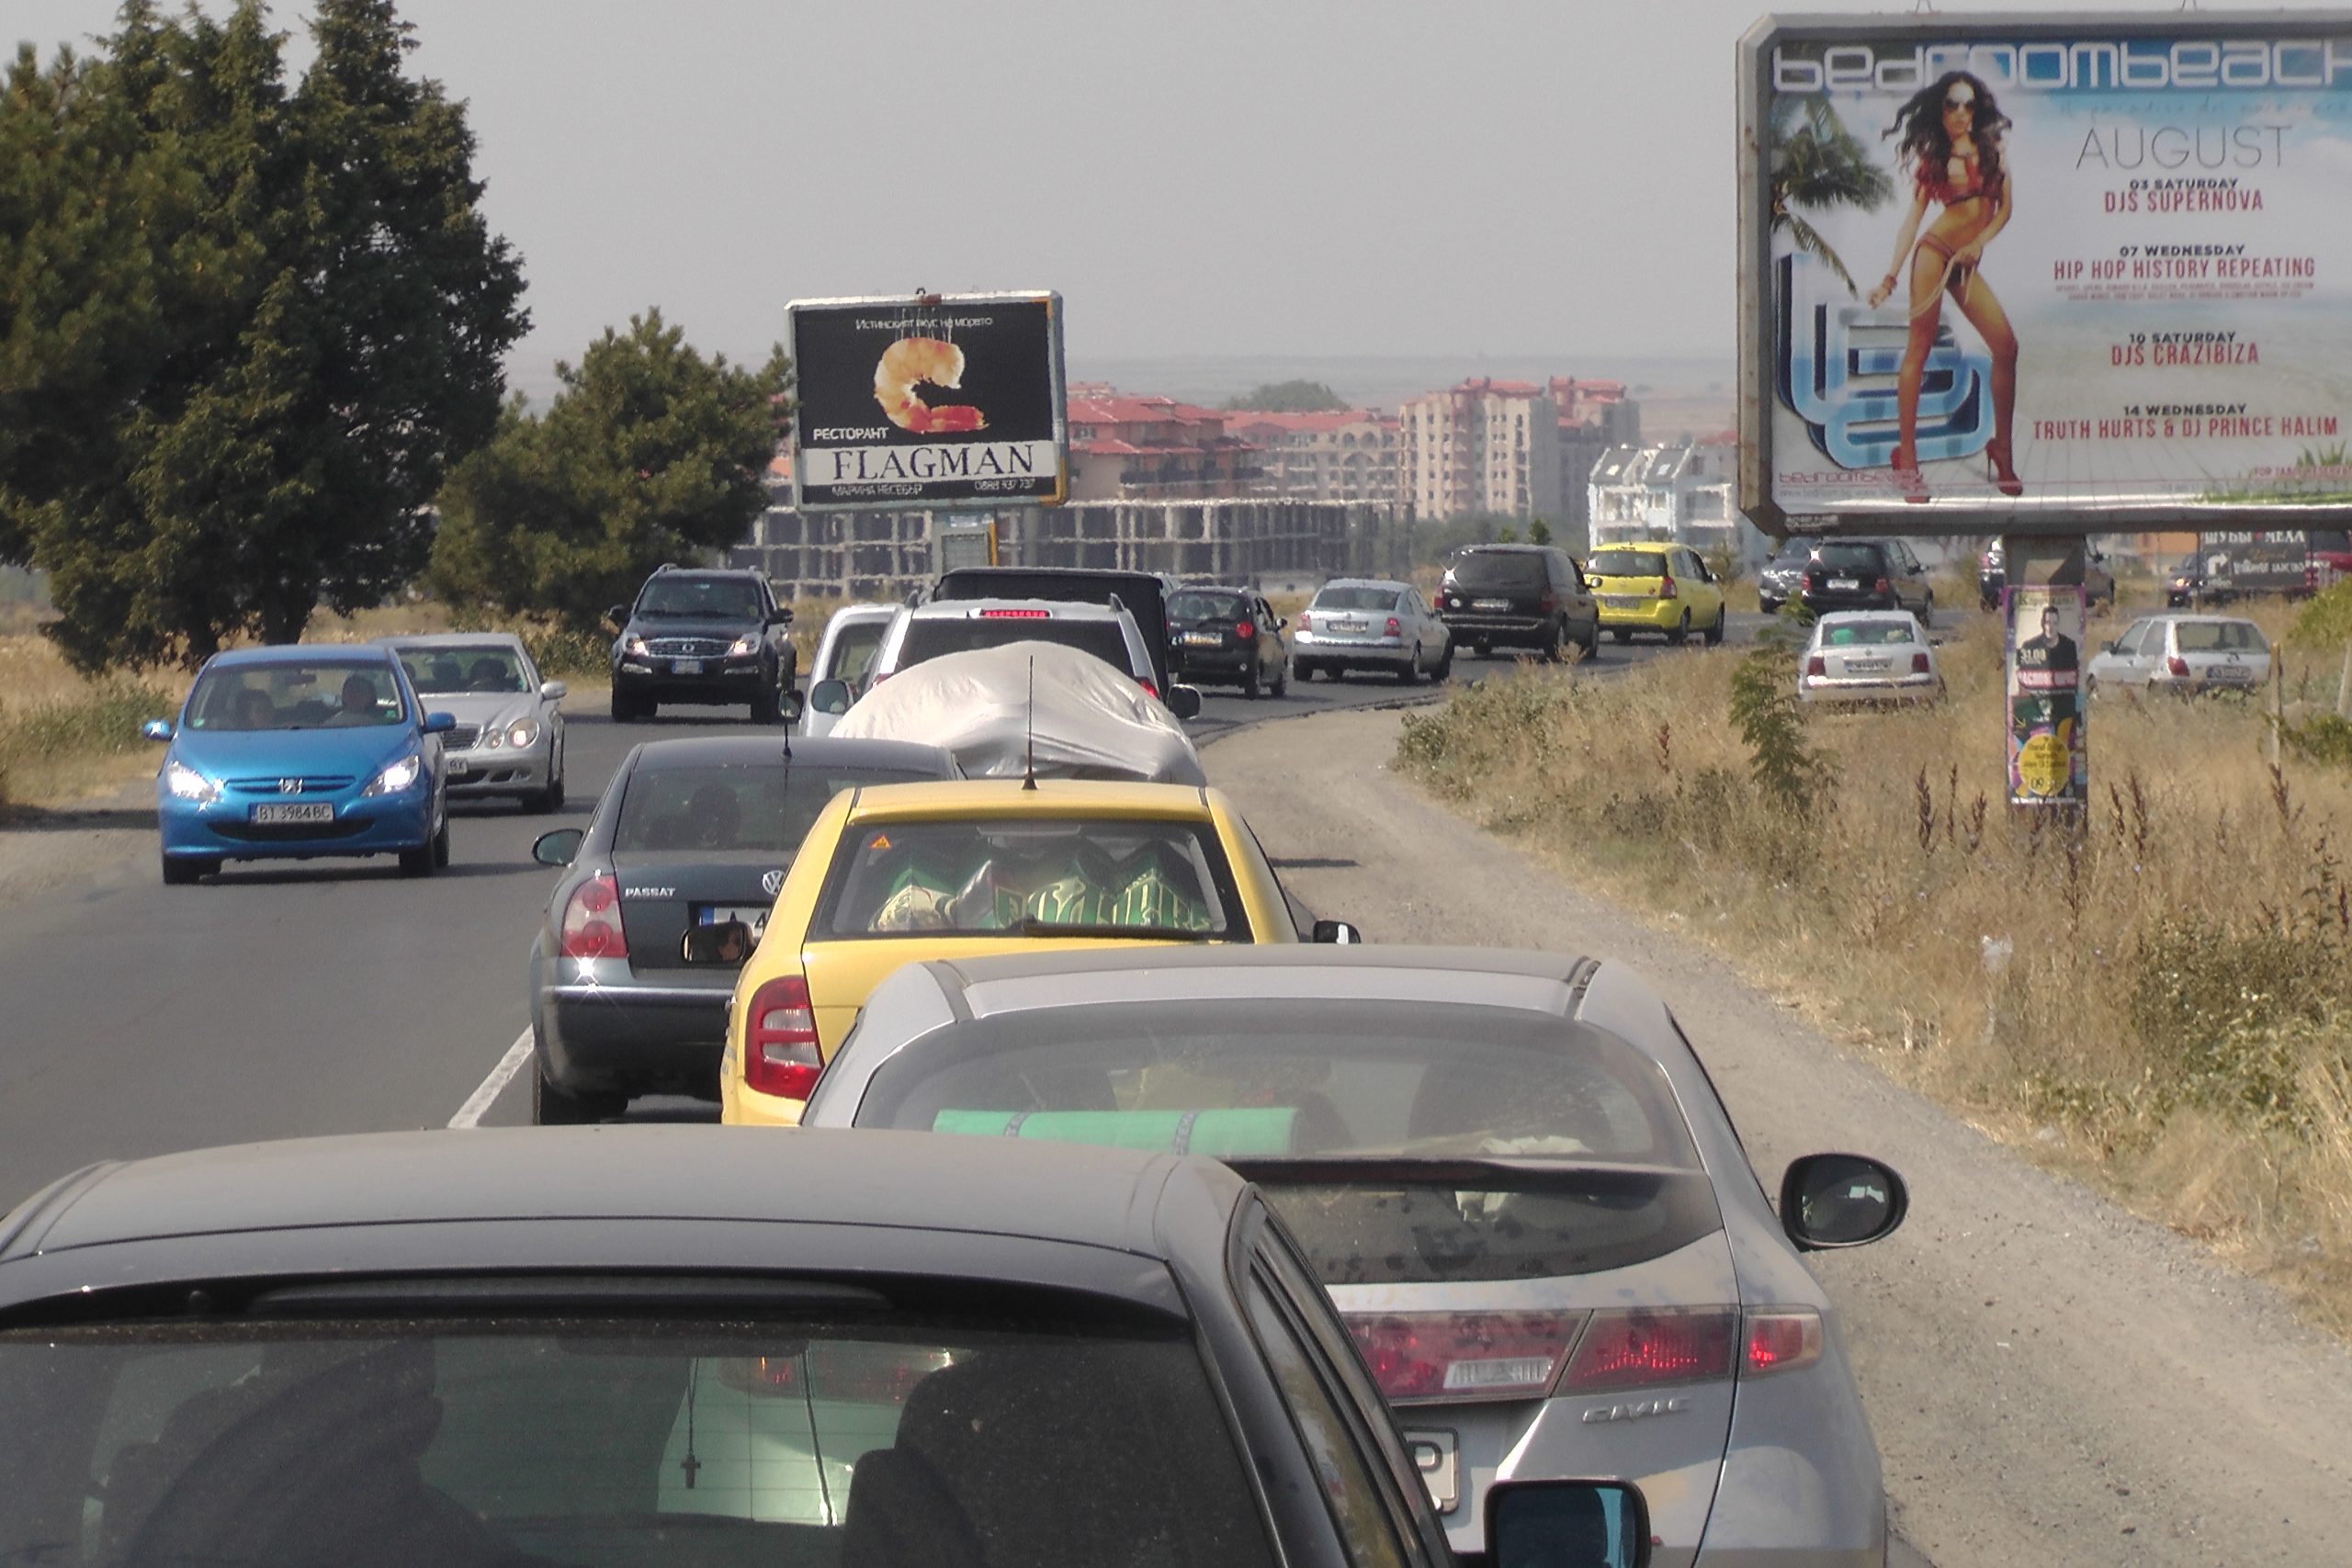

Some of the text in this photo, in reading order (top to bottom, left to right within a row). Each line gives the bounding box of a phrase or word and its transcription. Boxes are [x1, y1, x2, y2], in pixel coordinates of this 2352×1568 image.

[2075, 126, 2292, 170] AUGUST
[2130, 178, 2239, 191] 03 SATURDAY
[2104, 189, 2264, 213] DJS SUPERNOVA
[2120, 244, 2245, 257] 07 WEDNESDAY
[2053, 256, 2316, 280] HIP HOP HISTORY REPEATING
[2129, 332, 2237, 344] 10 SATURDAY
[2110, 343, 2260, 366] DJS CRAZIBIZA
[2123, 403, 2247, 416] 14 WEDNESDAY
[813, 427, 889, 441] РЕСТОРАНТ
[2033, 419, 2091, 440] TRUTH
[2098, 418, 2156, 439] HURTS
[2182, 418, 2202, 437] DJ
[2209, 417, 2274, 436] PRINCE
[2280, 416, 2338, 435] HALIM
[831, 444, 1035, 480] FLAGMAN
[625, 887, 676, 897] PASSAT
[1582, 1397, 1690, 1423] CIVIC
